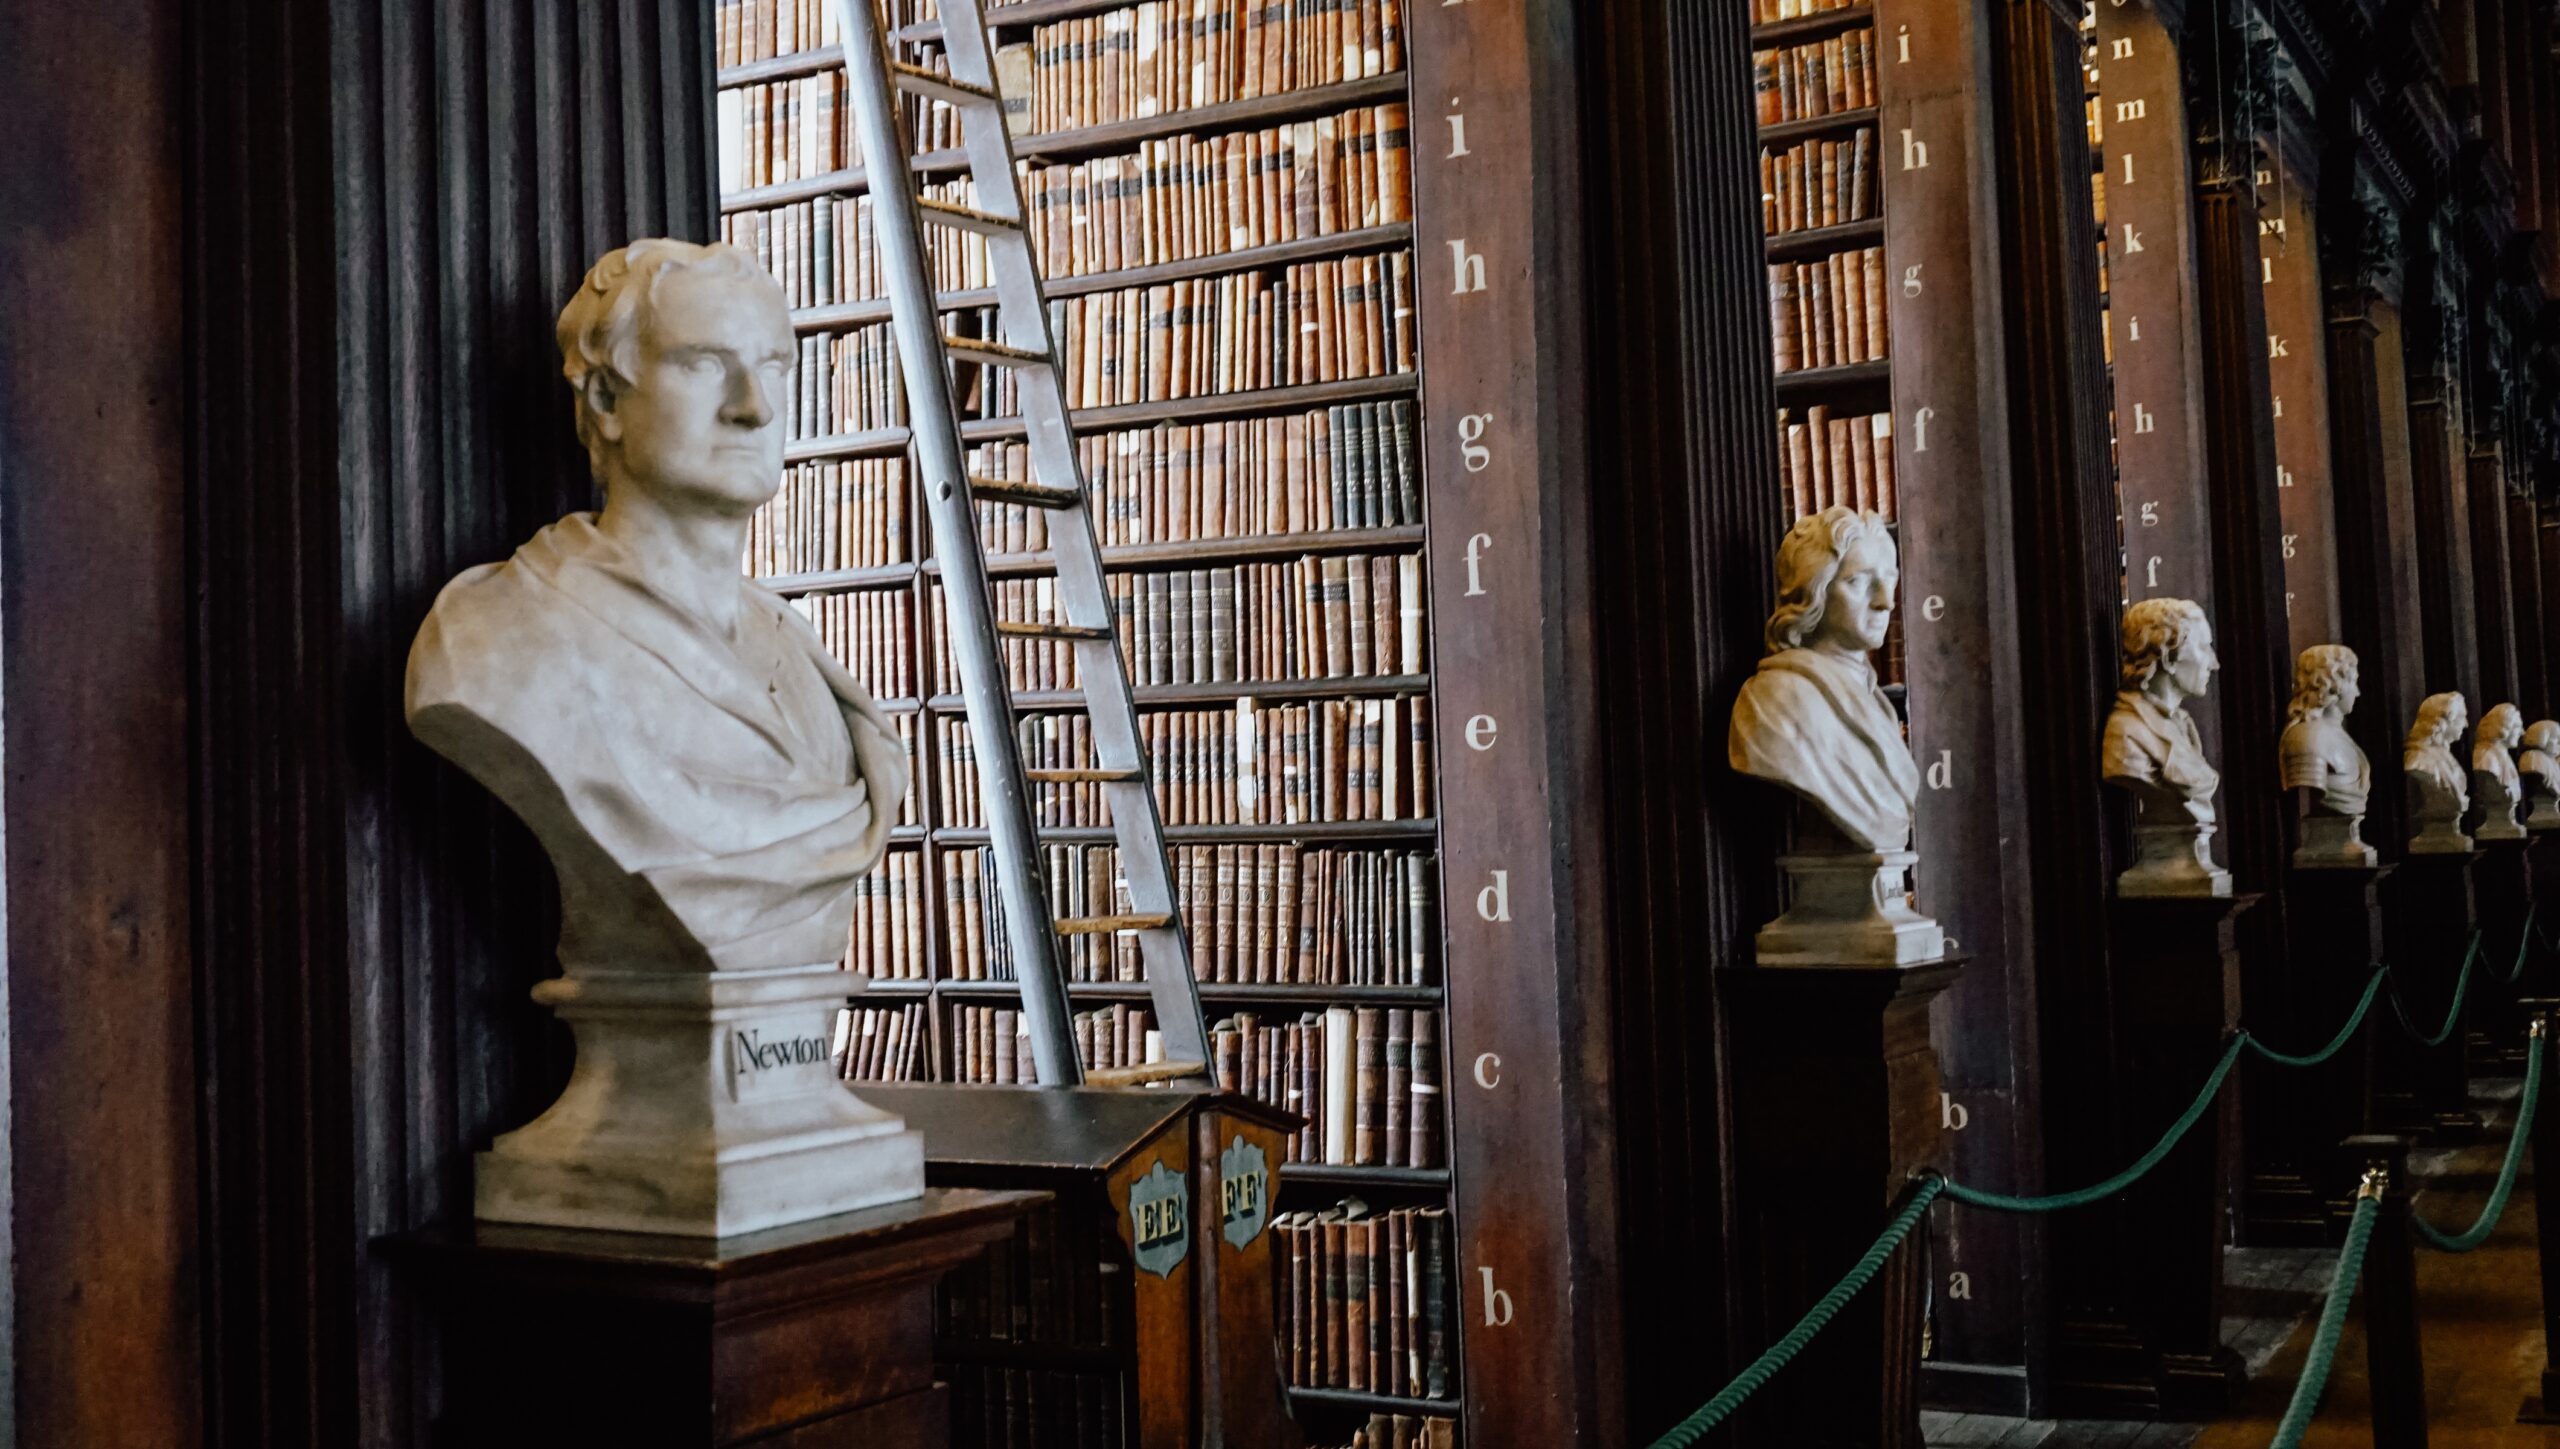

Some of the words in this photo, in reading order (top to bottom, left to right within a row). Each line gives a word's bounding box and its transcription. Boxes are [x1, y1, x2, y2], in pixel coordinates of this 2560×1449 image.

[1897, 24, 1910, 64] i
[2111, 37, 2134, 60] n
[1446, 97, 1470, 158] i
[2116, 98, 2146, 123] m
[1901, 128, 1929, 171] h
[2122, 153, 2135, 185] l
[2255, 170, 2272, 186] n
[2123, 223, 2144, 255] k
[1447, 239, 1486, 294] h
[1903, 263, 1923, 298] g
[2129, 316, 2140, 341] i
[2268, 335, 2288, 358] k
[2133, 402, 2154, 434] h
[2272, 395, 2283, 418] i
[1459, 413, 1493, 472] g
[1913, 406, 1934, 453] f
[2276, 464, 2293, 488] h
[2140, 500, 2159, 526] g
[2281, 534, 2298, 559] g
[1463, 533, 1491, 596] f
[2146, 555, 2162, 588] f
[1921, 594, 1945, 622] e
[1465, 715, 1496, 751] e
[1926, 749, 1952, 790] d
[1477, 870, 1510, 921] d
[737, 1028, 828, 1074] Newton
[1474, 1053, 1500, 1089] c
[1940, 1092, 1969, 1131] b
[1221, 1170, 1262, 1222] FF
[1136, 1194, 1183, 1247] EE
[1478, 1267, 1513, 1326] b
[1949, 1271, 1972, 1300] a
